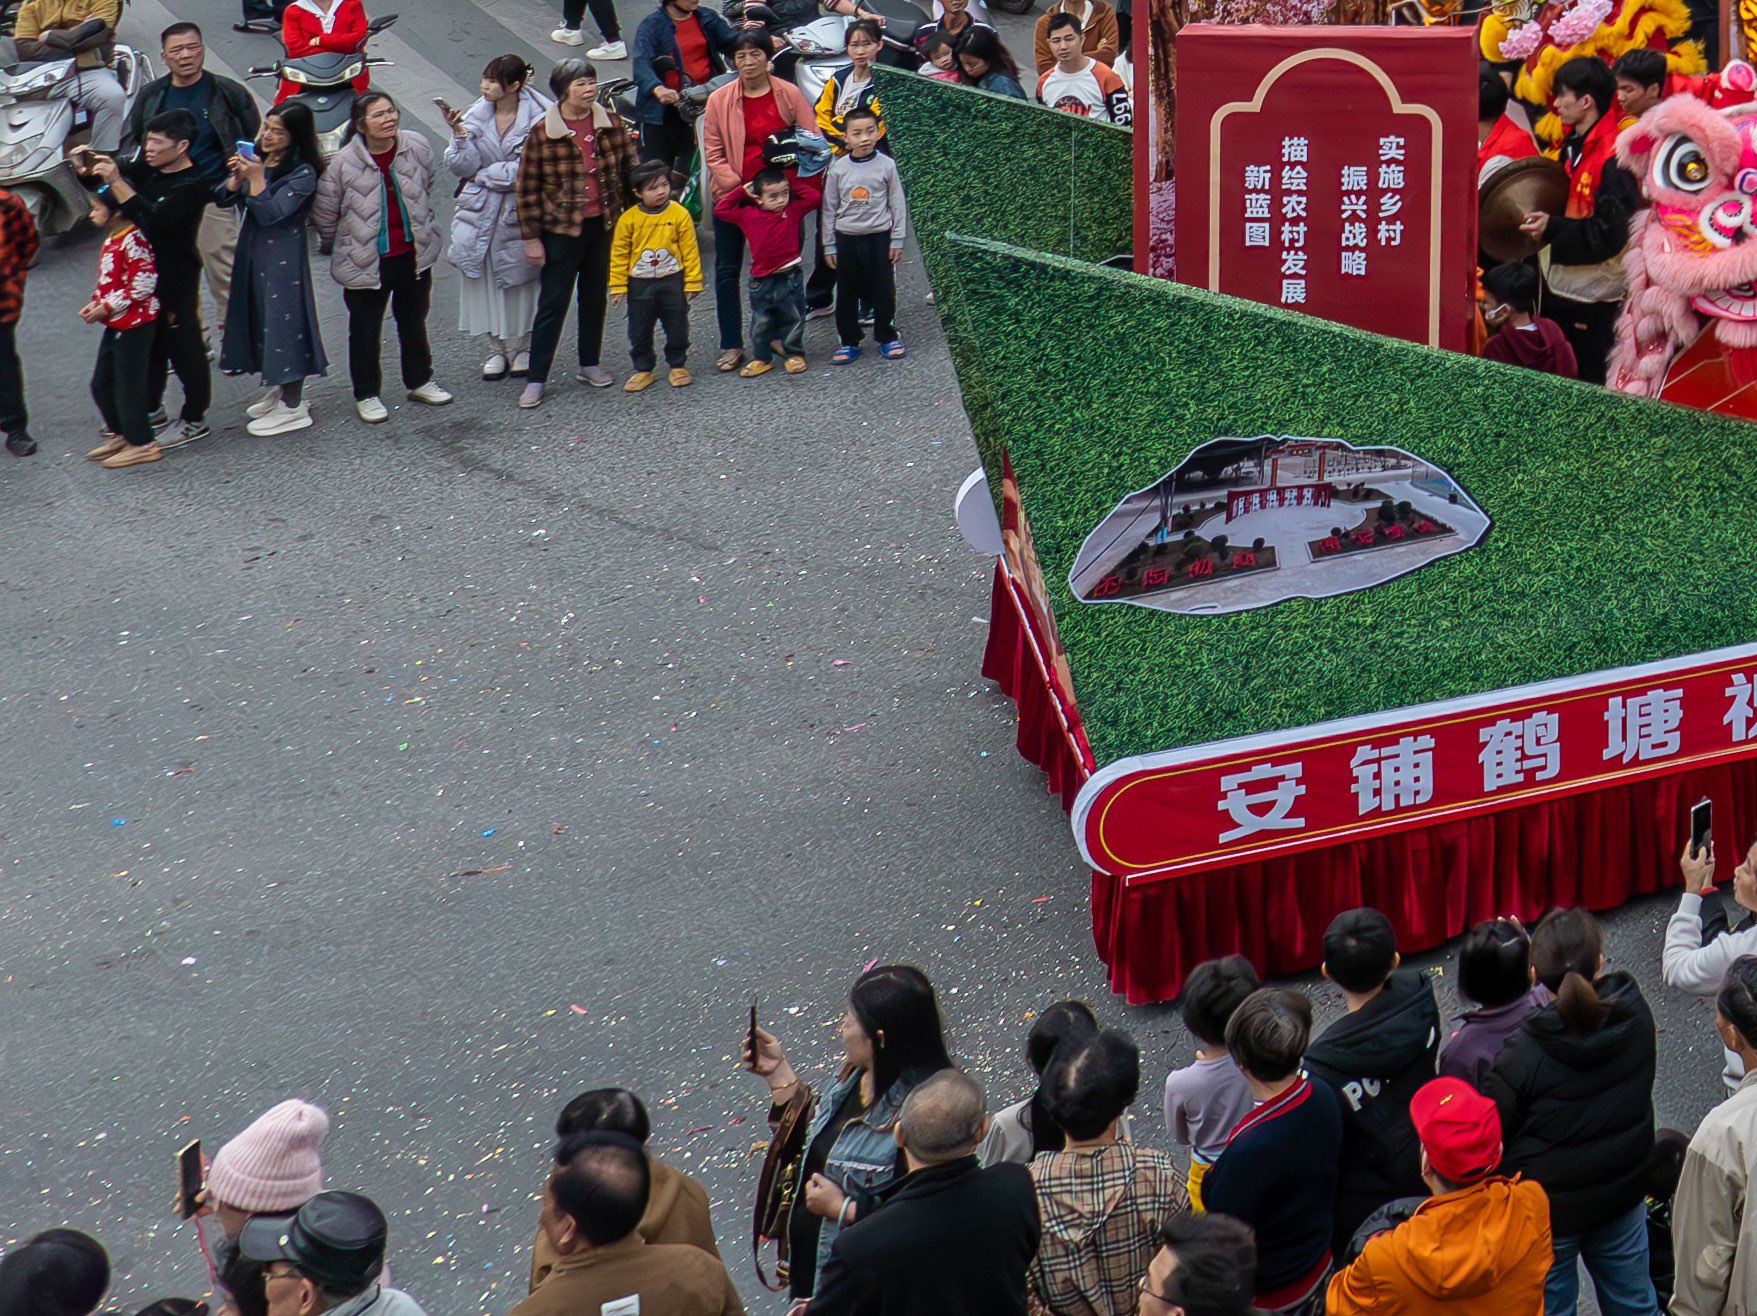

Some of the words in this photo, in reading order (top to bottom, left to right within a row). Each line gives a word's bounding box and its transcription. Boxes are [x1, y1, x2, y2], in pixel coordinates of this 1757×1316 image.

[1243, 164, 1273, 248] 新蓝图
[1279, 136, 1309, 306] 描绘农村发展
[1340, 164, 1370, 278] 振兴战略
[1375, 134, 1407, 248] 实施乡村
